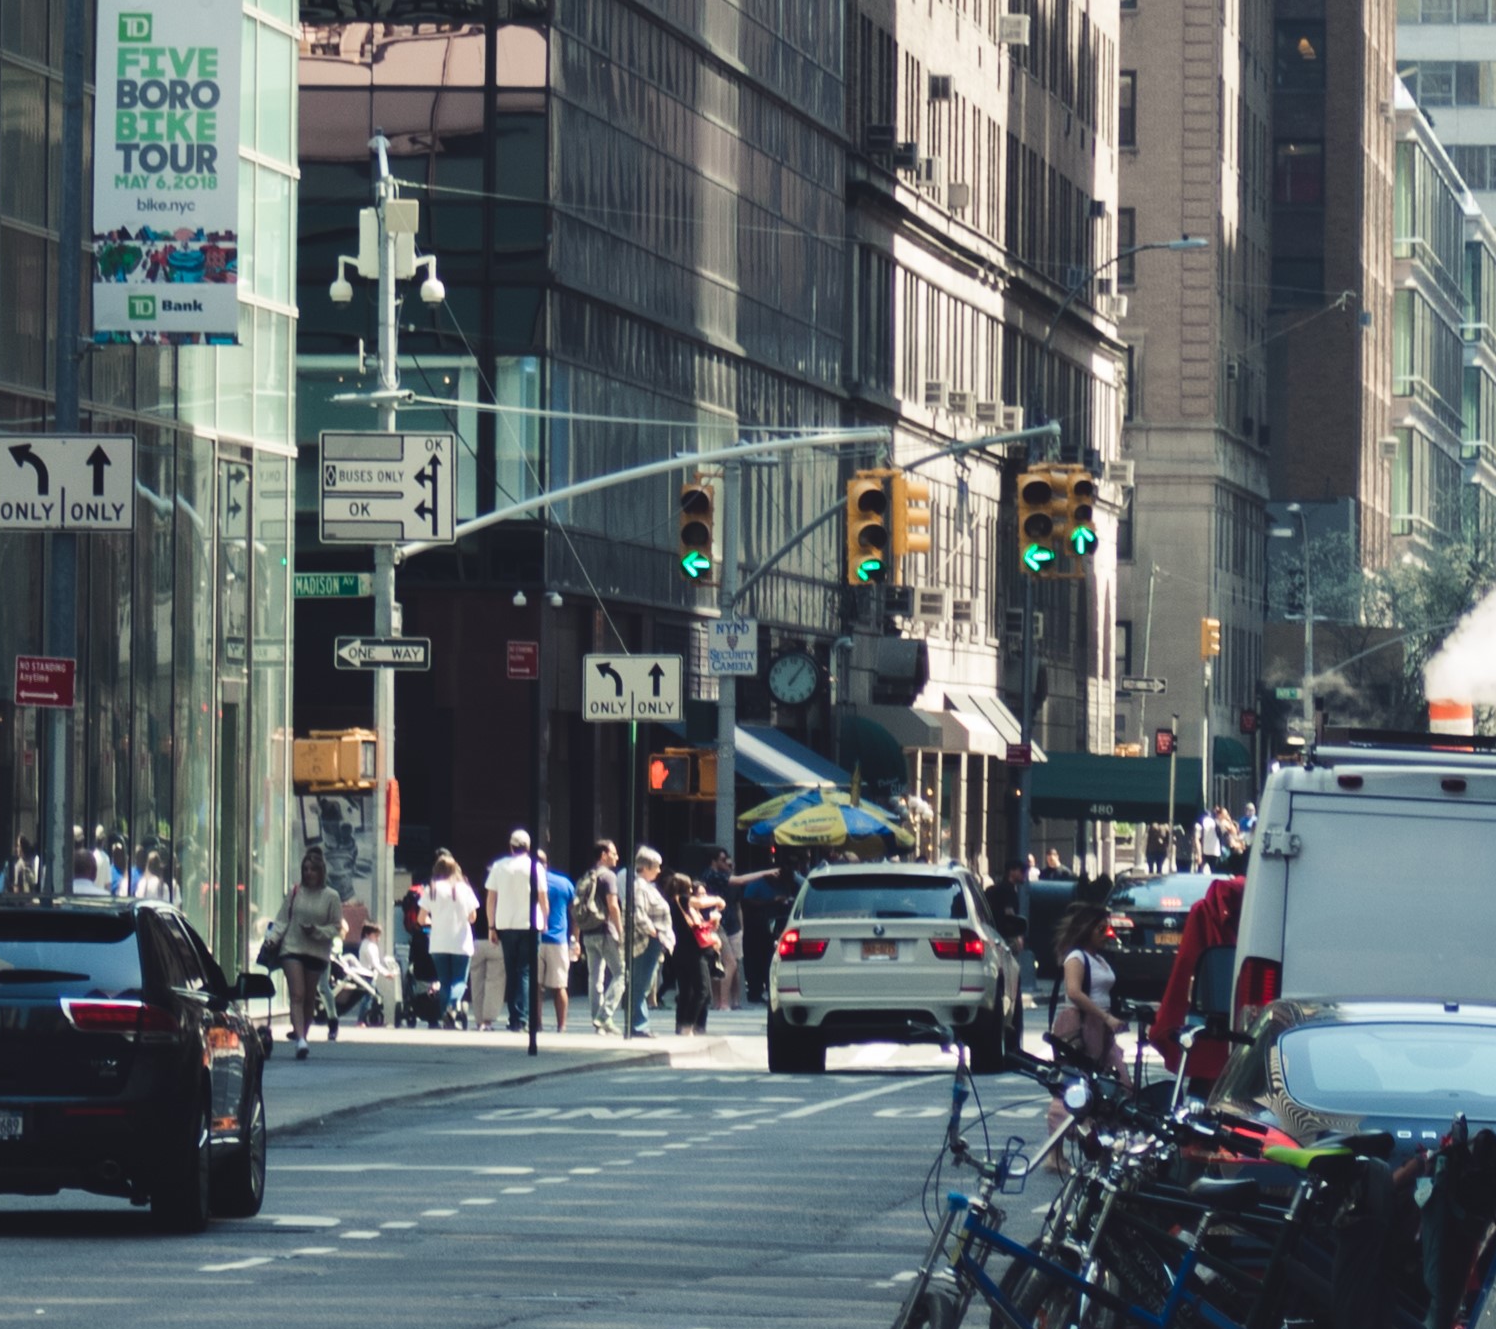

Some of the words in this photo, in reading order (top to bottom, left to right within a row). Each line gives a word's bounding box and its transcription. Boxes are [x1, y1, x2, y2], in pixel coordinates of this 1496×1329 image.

[121, 16, 150, 38] TD
[117, 47, 218, 78] FIVE
[116, 79, 220, 110] BORO
[115, 111, 217, 142] BIKE
[115, 143, 218, 174] TOUR
[114, 174, 151, 190] MAY
[136, 198, 195, 214] bike.nyc
[161, 299, 203, 313] Bank
[425, 439, 444, 452] OK
[338, 471, 373, 482] BUSES
[377, 471, 404, 483] ONLY
[0, 502, 54, 520] ONLY
[71, 502, 125, 521] ONLY
[349, 502, 371, 518] OK
[295, 576, 340, 595] MADISON
[348, 647, 376, 660] ONE
[391, 647, 421, 660] WAY
[590, 701, 627, 715] ONLY
[637, 701, 675, 715] ONLY
[1089, 804, 1114, 815] 480
